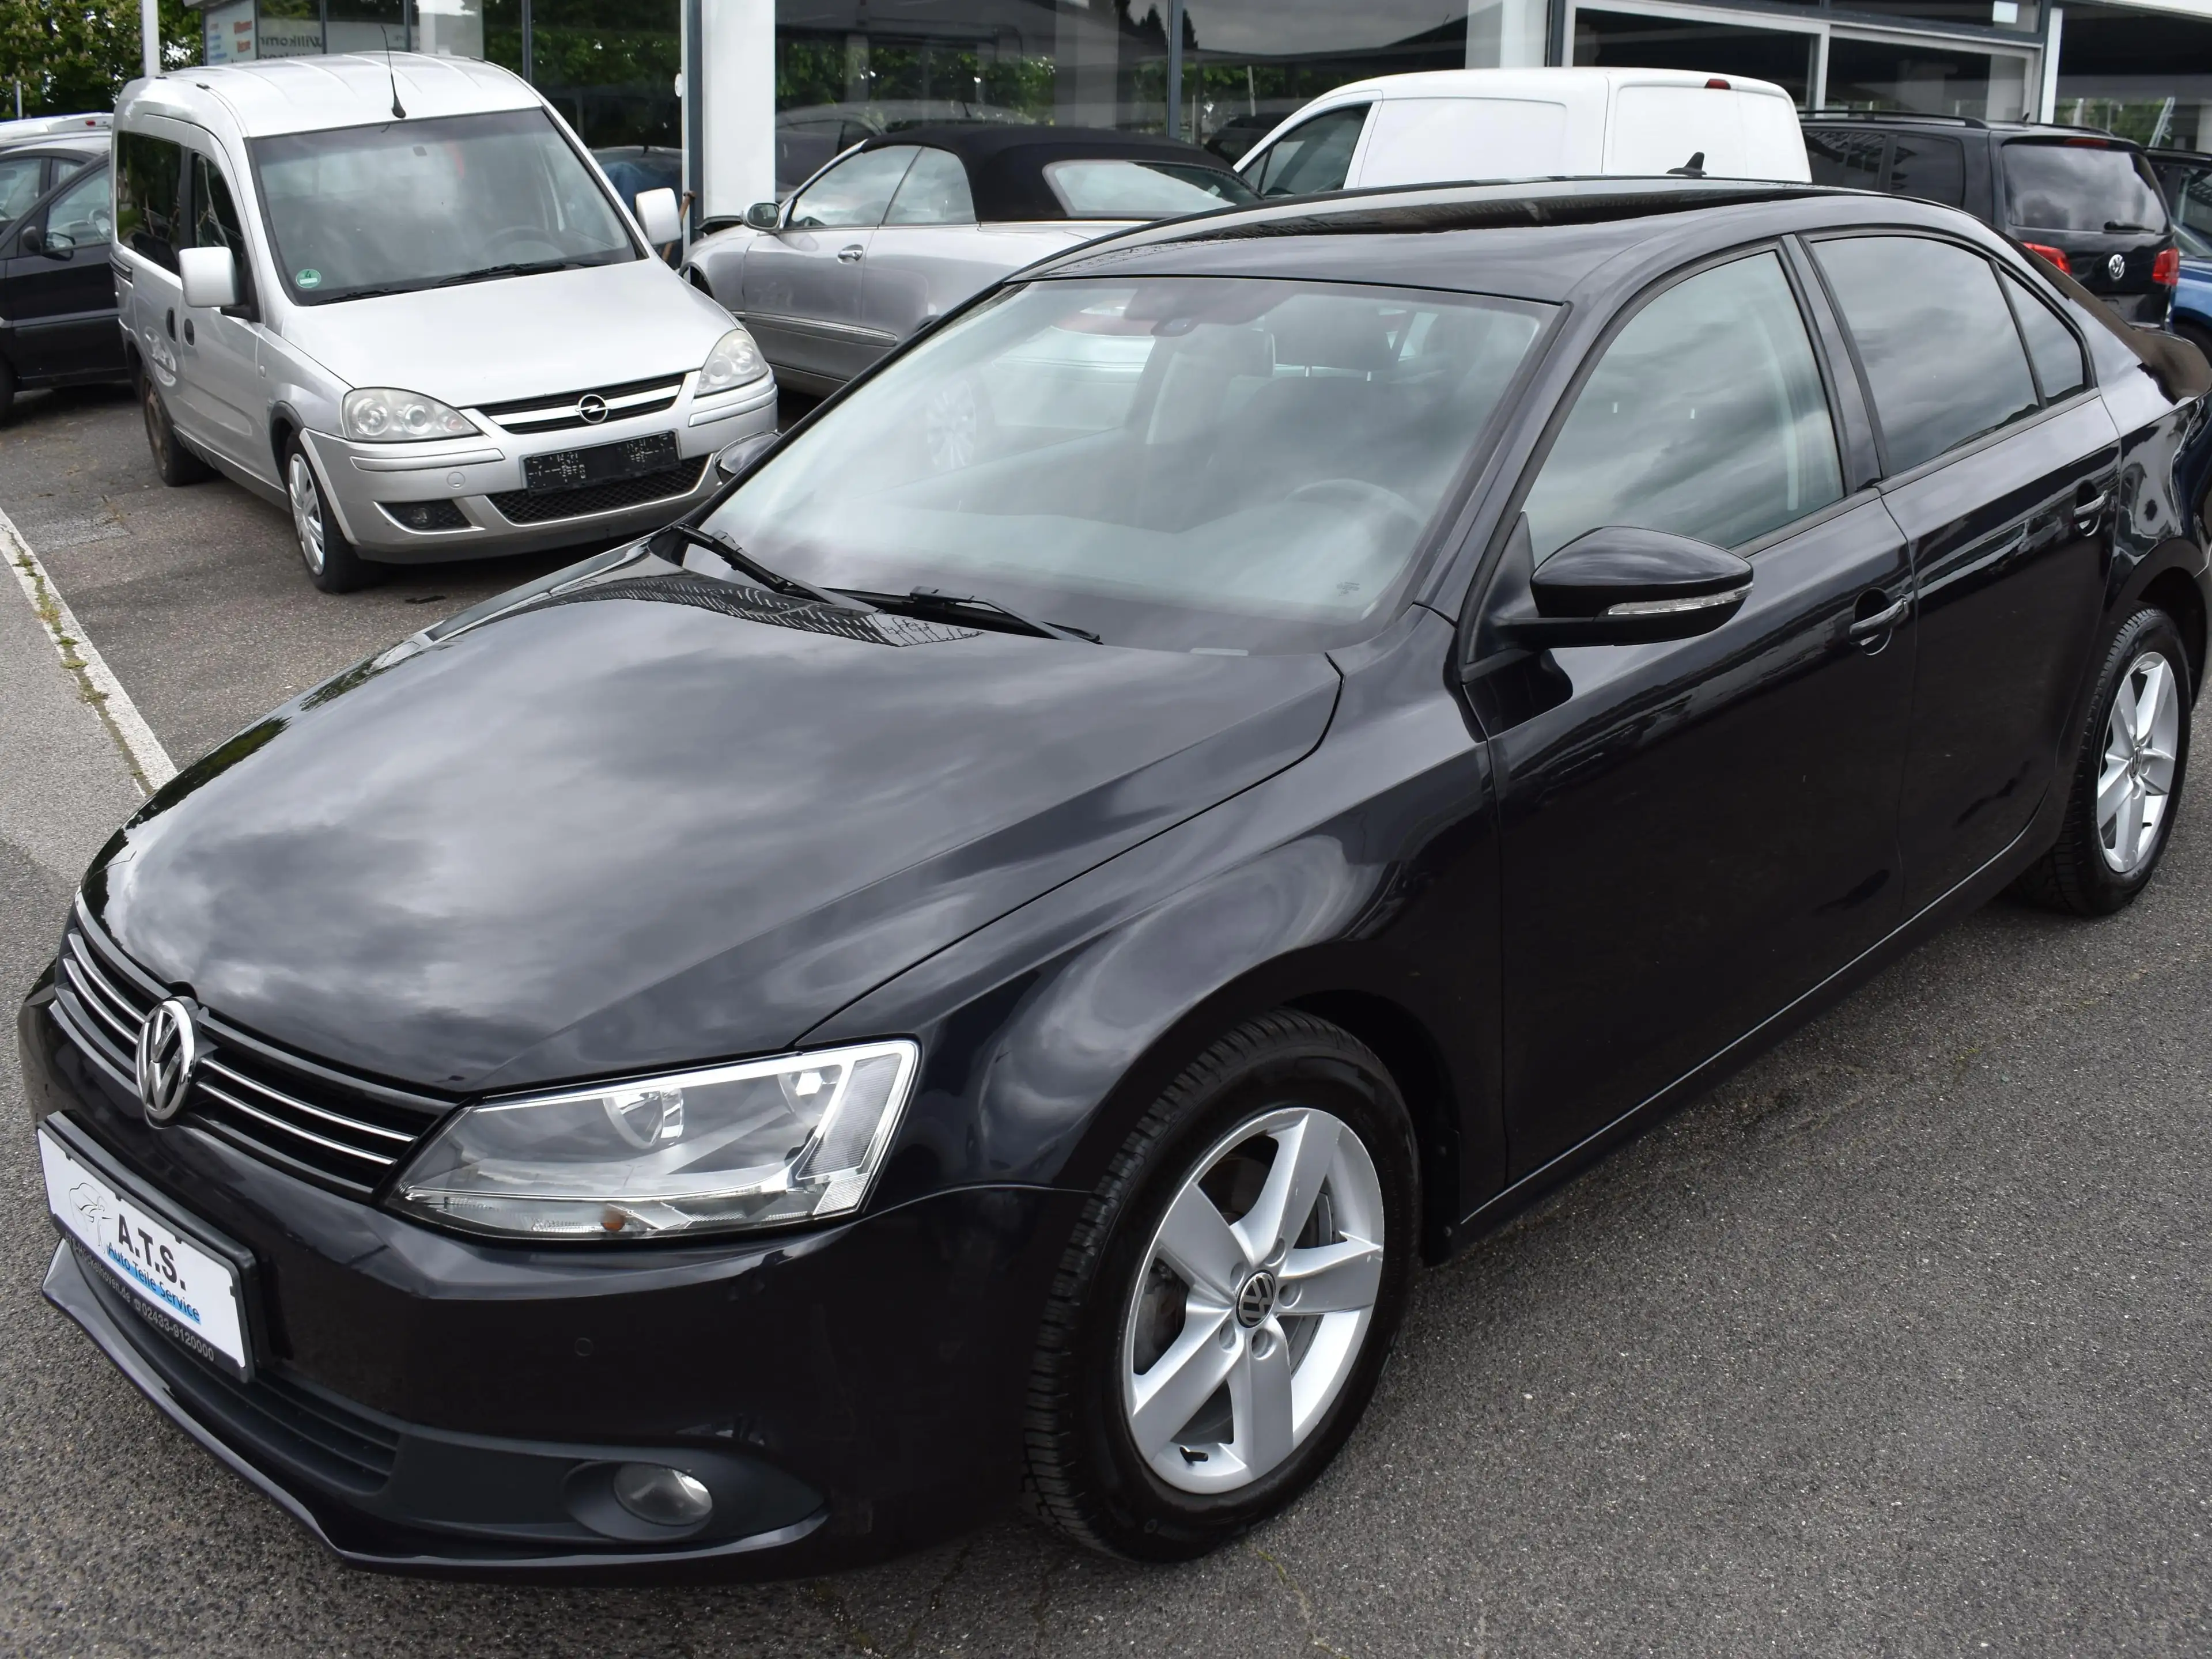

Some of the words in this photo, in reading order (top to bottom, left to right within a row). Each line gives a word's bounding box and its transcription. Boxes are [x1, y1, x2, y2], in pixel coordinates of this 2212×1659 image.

[108, 1242, 130, 1270] Auto
[133, 1260, 157, 1291] Teile
[159, 1281, 199, 1321] Service
[119, 1214, 186, 1291] A.T.S.
